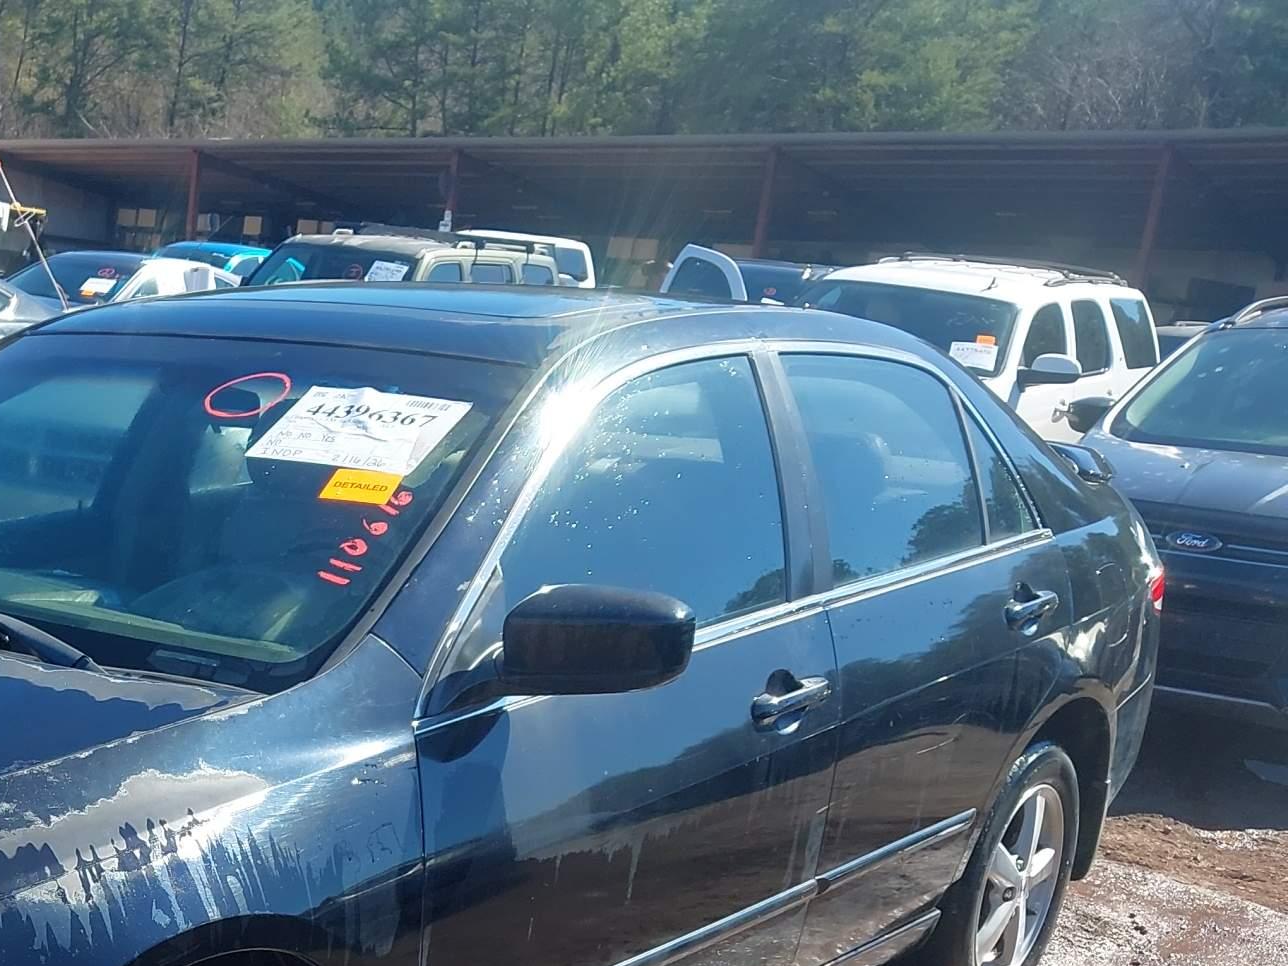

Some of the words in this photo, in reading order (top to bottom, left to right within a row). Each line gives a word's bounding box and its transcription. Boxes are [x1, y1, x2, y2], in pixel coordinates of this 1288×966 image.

[306, 402, 439, 428] 44396367
[333, 481, 389, 493] DETAILED
[1176, 532, 1209, 548] Ford
